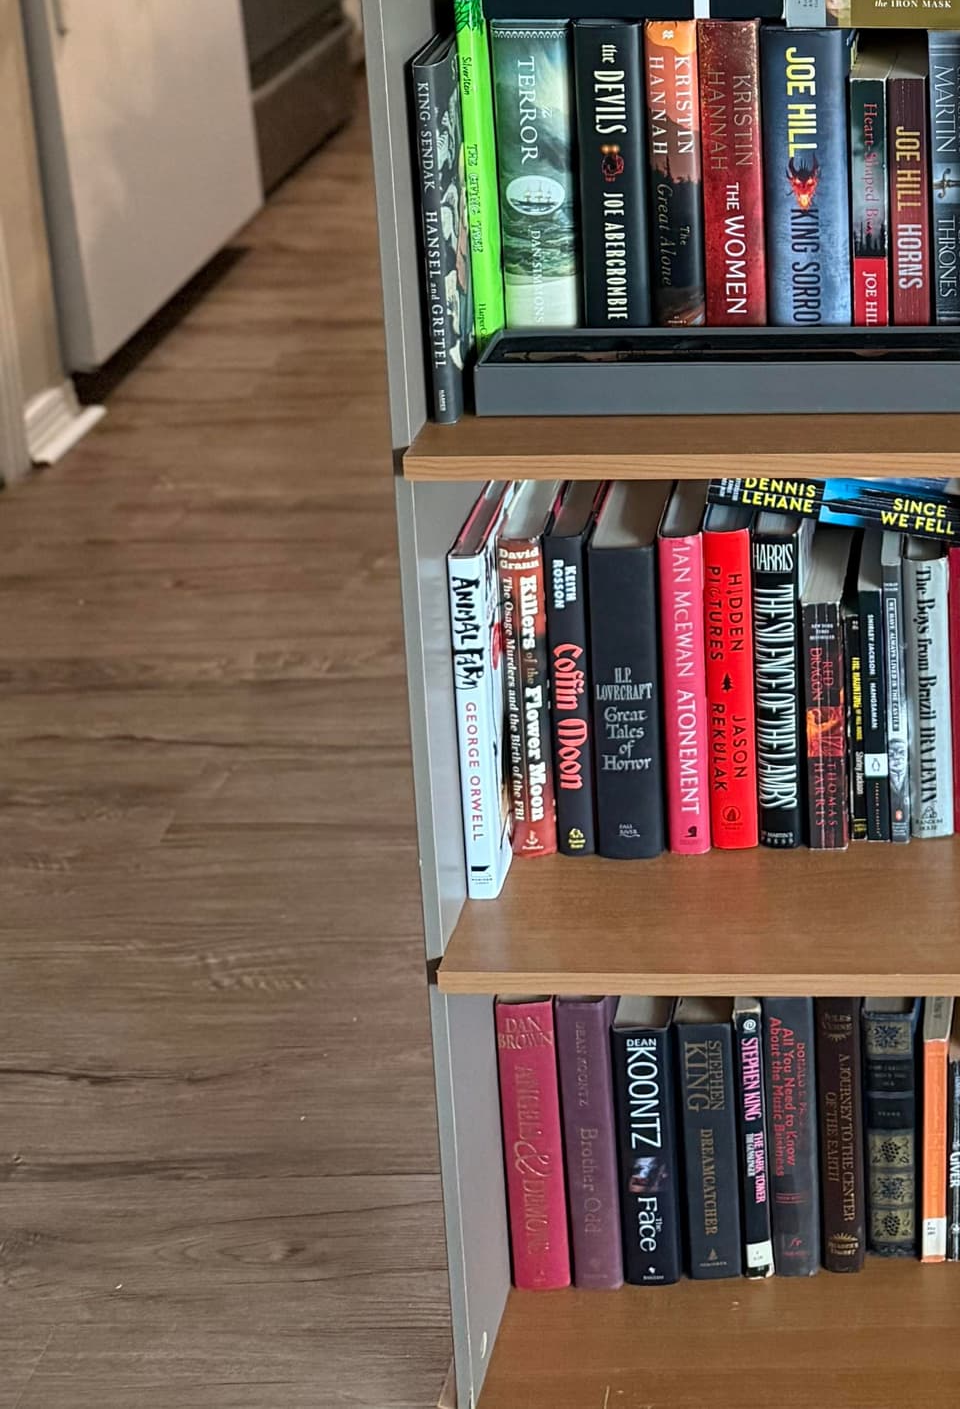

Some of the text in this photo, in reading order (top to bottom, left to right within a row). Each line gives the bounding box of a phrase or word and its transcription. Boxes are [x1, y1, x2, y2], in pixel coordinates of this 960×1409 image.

[875, 0, 951, 8] the IRON MASK
[649, 56, 669, 156] HANNAH
[675, 56, 694, 154] KRISTIN
[594, 43, 629, 321] the DEVILS JOE ABERCROMBIE
[785, 47, 821, 326] JOE HILL KING SORRO
[724, 183, 747, 314] THE WOMEN
[500, 548, 539, 559] David
[500, 560, 539, 569] Grann
[753, 543, 793, 572] HARRIS
[707, 565, 723, 662] PICTURES
[728, 573, 744, 654] HIDDEN
[596, 683, 652, 700] LOVECRAFT
[614, 668, 631, 683] H.P.
[673, 546, 699, 815] IAN McEWAN ATONEMENT
[604, 709, 647, 722] Great
[606, 725, 644, 738] Tales
[619, 741, 634, 756] of
[713, 703, 728, 791] REKULAK
[732, 715, 747, 779] JASON
[465, 701, 483, 842] GEORGE ORWELL
[601, 755, 651, 771] Horror
[498, 1031, 552, 1049] BROWN
[505, 1016, 541, 1032] DAN
[626, 1039, 656, 1047] DEAN
[626, 1047, 662, 1149] KOONTZ
[685, 1042, 710, 1112] KING
[709, 1040, 724, 1110] STEPHEN
[741, 1037, 761, 1121] STEPHEN KING
[770, 1017, 785, 1177] About the Music Business
[782, 1028, 797, 1166] All You Need to Know
[638, 1197, 658, 1252] Face
